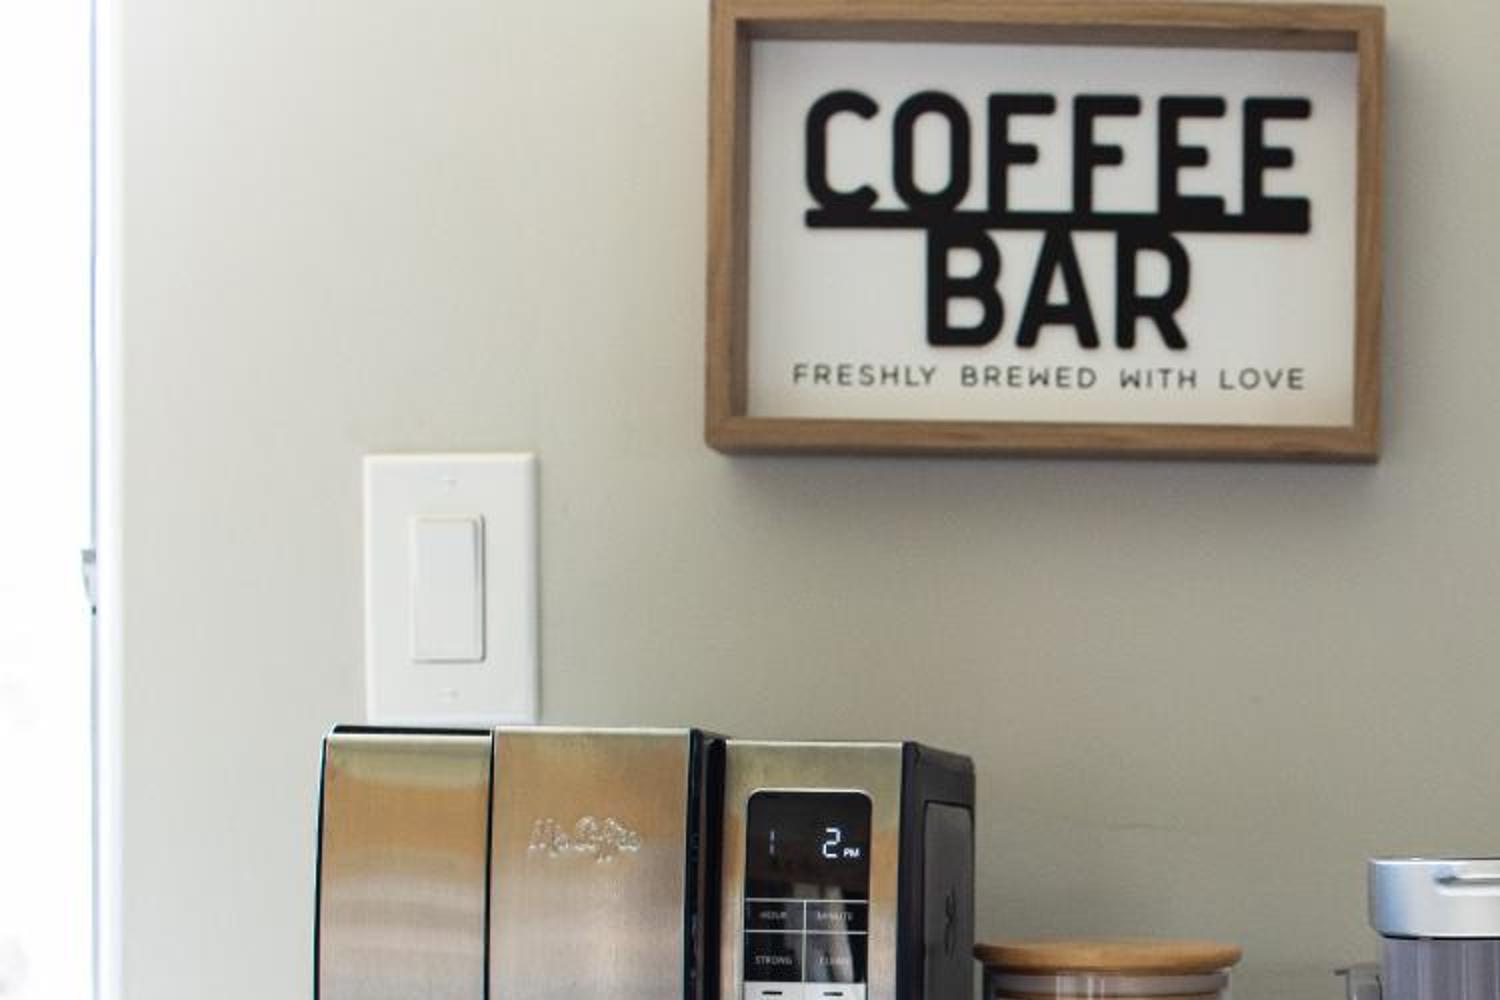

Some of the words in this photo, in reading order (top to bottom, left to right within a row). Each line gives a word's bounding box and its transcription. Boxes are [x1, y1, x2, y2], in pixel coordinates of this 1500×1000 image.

[804, 90, 1311, 232] COFFEE
[927, 229, 1192, 350] BAR
[793, 363, 936, 387] FRESHLY
[960, 364, 1097, 389] BREWED
[1120, 367, 1197, 389] WITH
[1219, 368, 1306, 390] LOVE
[843, 847, 860, 857] PM
